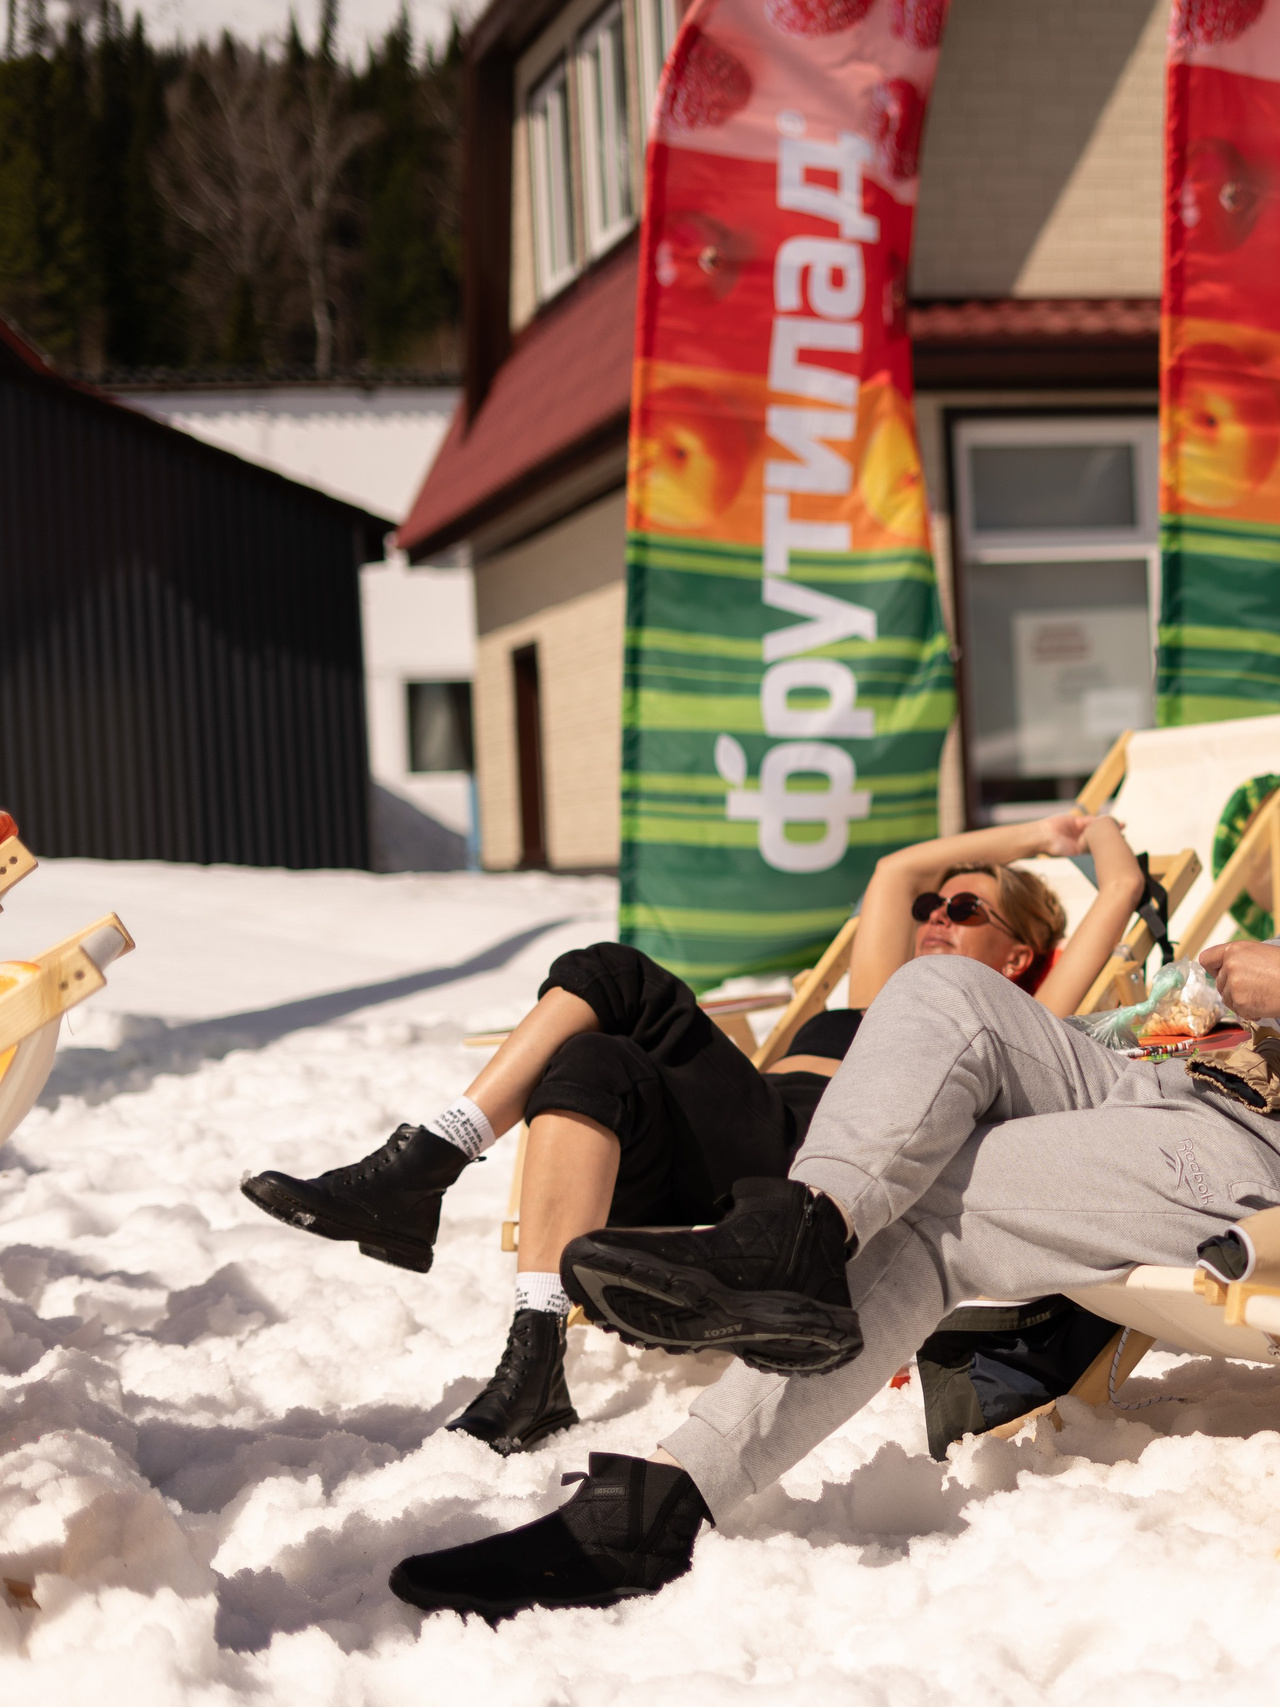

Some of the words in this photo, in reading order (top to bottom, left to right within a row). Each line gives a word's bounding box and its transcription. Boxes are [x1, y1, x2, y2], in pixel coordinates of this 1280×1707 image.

[714, 129, 880, 874] фрутилад
[1178, 1138, 1214, 1205] Reebok
[704, 1323, 743, 1338] ASCOT
